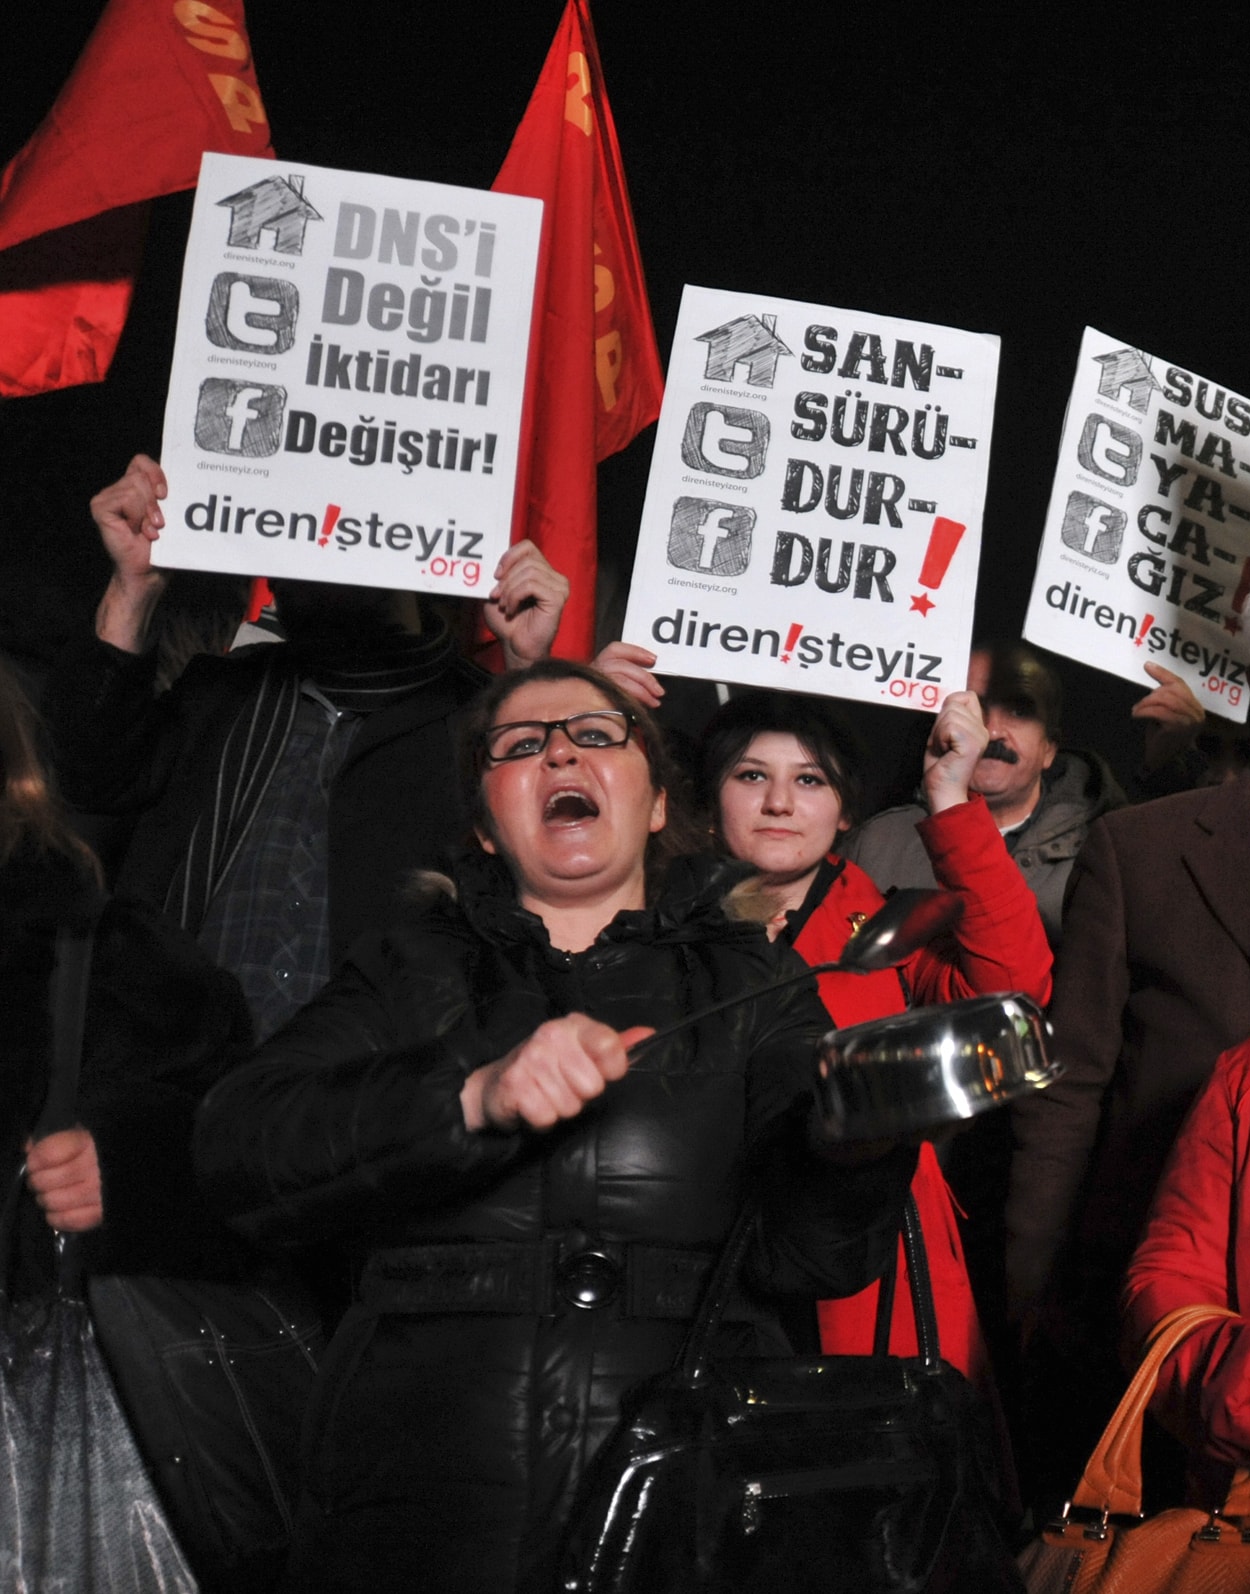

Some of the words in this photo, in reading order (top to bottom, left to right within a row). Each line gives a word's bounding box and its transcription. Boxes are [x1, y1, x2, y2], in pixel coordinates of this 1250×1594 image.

[321, 266, 493, 344] Değil
[305, 334, 491, 407] İktidarı
[800, 324, 964, 392] SAN-
[283, 409, 498, 475] Değiştir!
[791, 389, 978, 460] SÜRÜ-
[780, 458, 938, 528] DUR-
[1150, 453, 1250, 523] YA-
[1137, 504, 1237, 567] CA-
[421, 556, 481, 587] .org
[881, 680, 939, 708] .org
